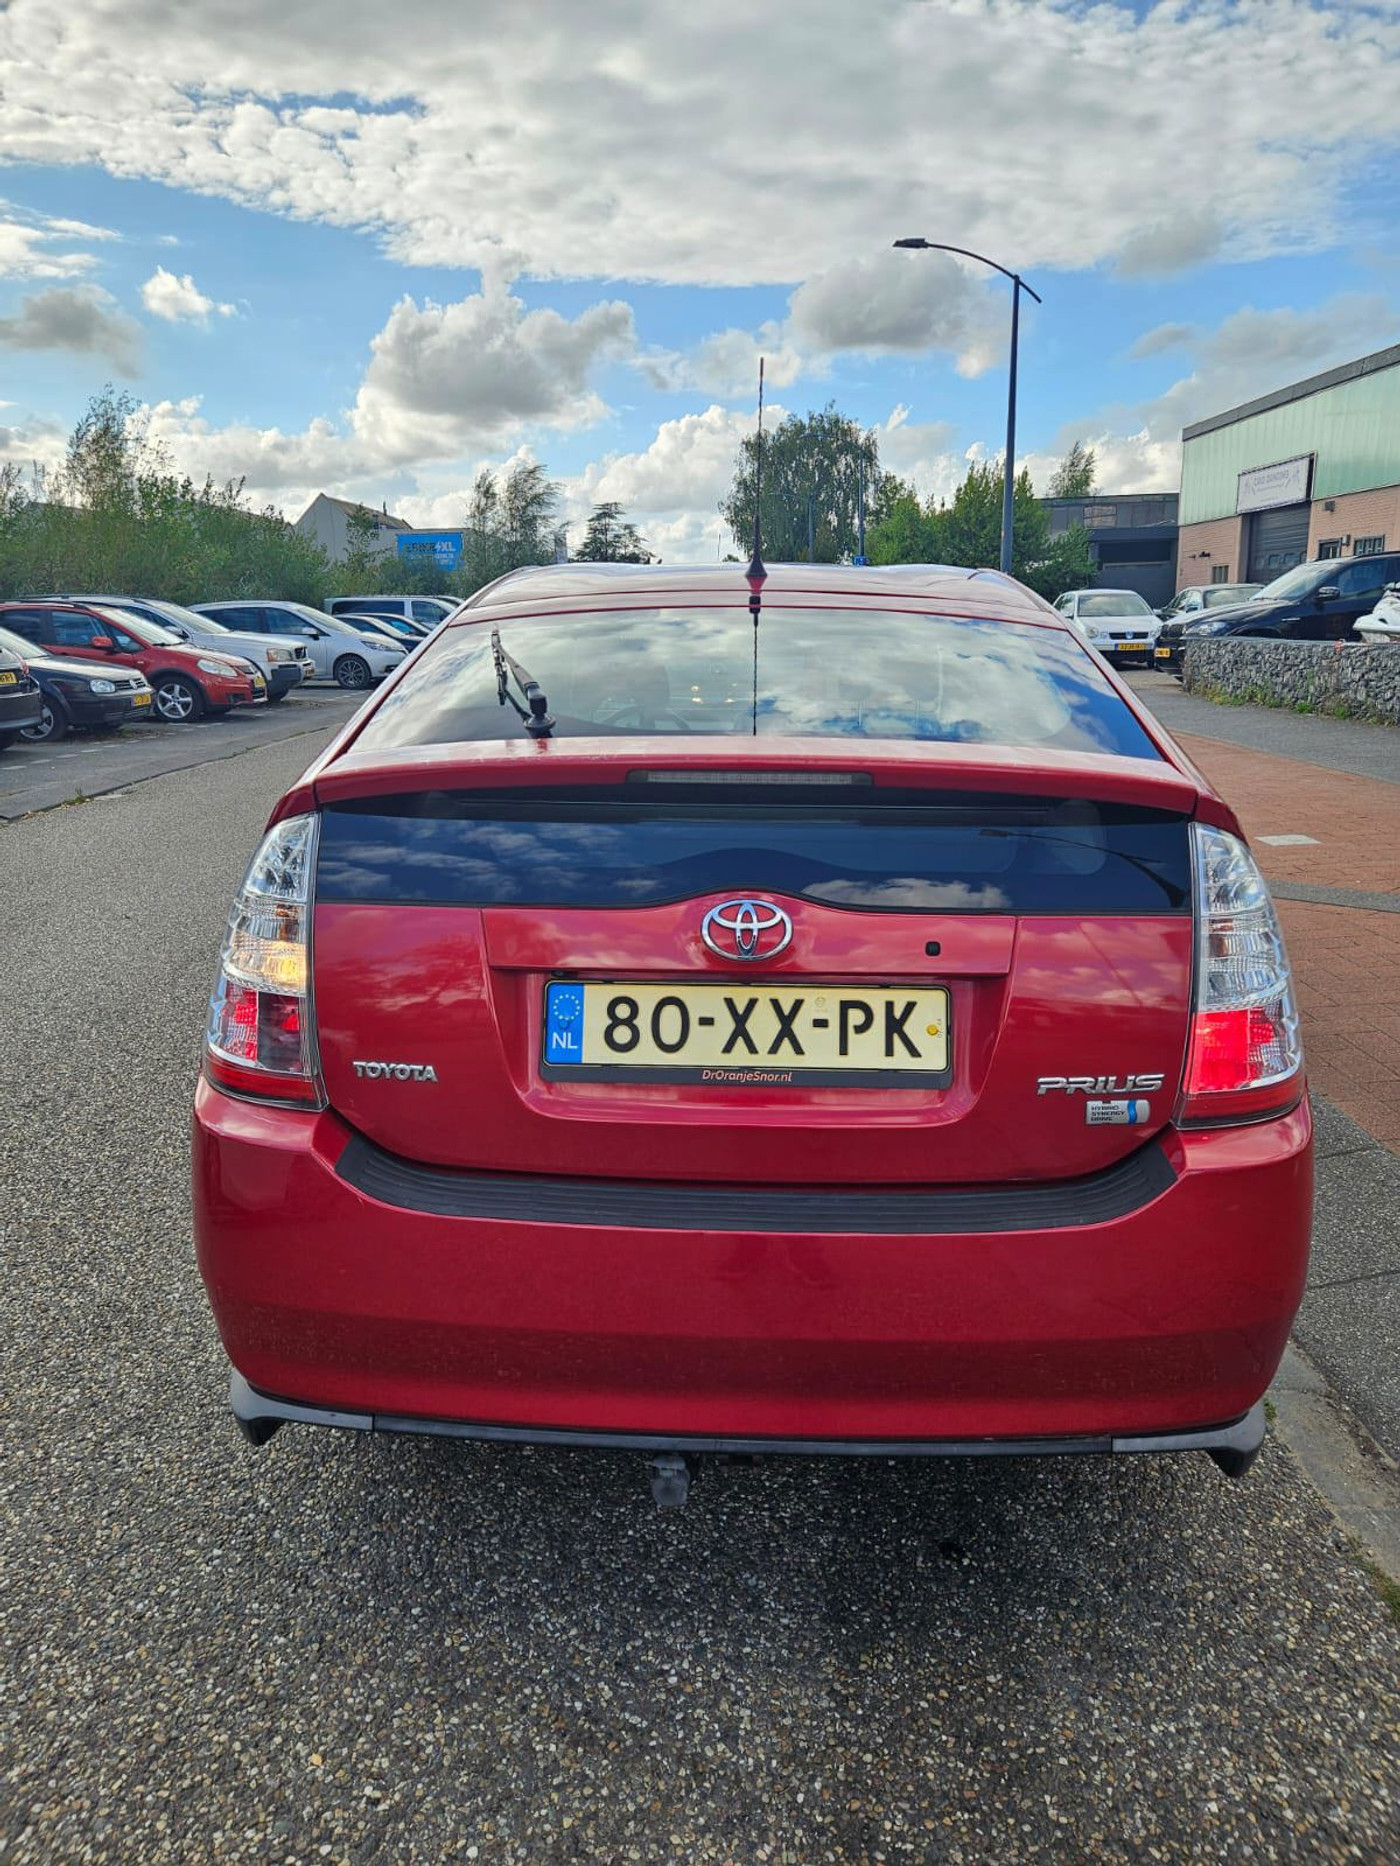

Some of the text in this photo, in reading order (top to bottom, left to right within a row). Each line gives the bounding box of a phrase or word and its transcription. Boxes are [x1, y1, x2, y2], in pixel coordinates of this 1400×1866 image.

[603, 996, 922, 1058] 80-XX-PK
[551, 1031, 578, 1049] NL
[352, 1061, 438, 1082] TOYOTA
[702, 1069, 792, 1083] DrOranjeSnor.nl
[1037, 1073, 1165, 1095] PRIUS
